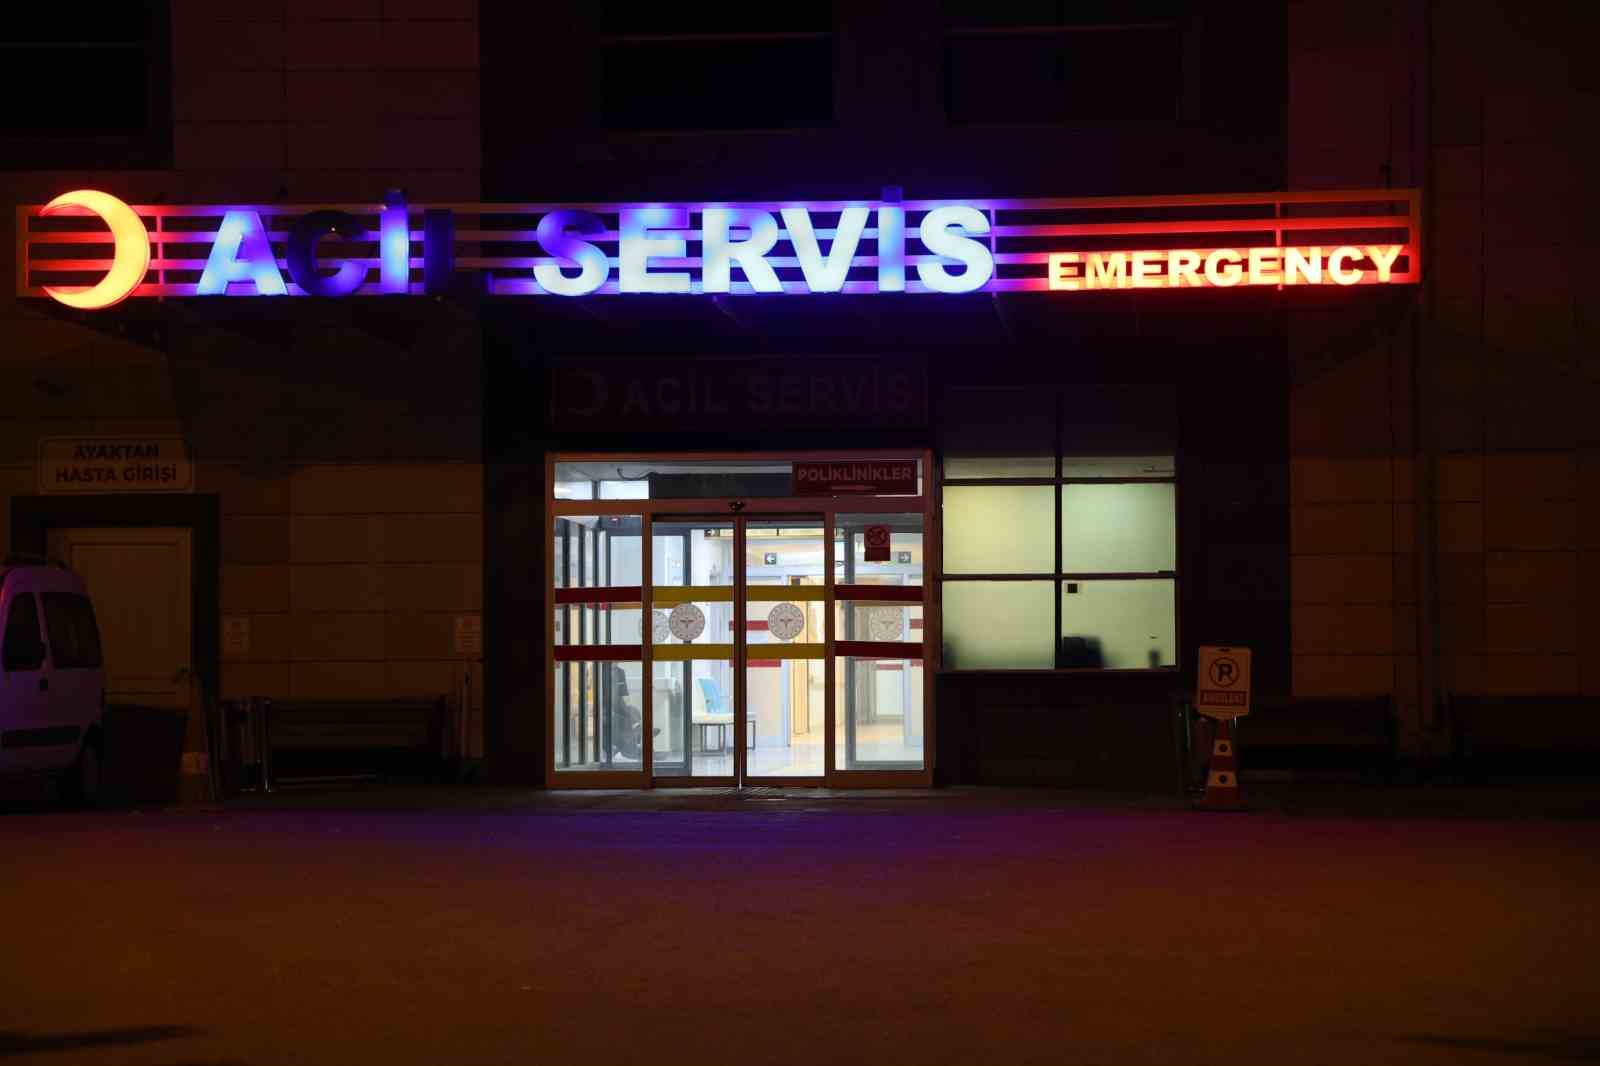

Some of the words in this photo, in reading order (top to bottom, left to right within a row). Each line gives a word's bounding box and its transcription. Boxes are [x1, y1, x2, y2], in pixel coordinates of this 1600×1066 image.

[196, 188, 491, 297] ACİL
[533, 187, 995, 297] SERVİS
[1048, 244, 1404, 291] EMERGENCY
[73, 443, 160, 459] AYAKTAN
[56, 467, 116, 482] HASTA
[797, 464, 912, 481] POLİKLİNİKLER
